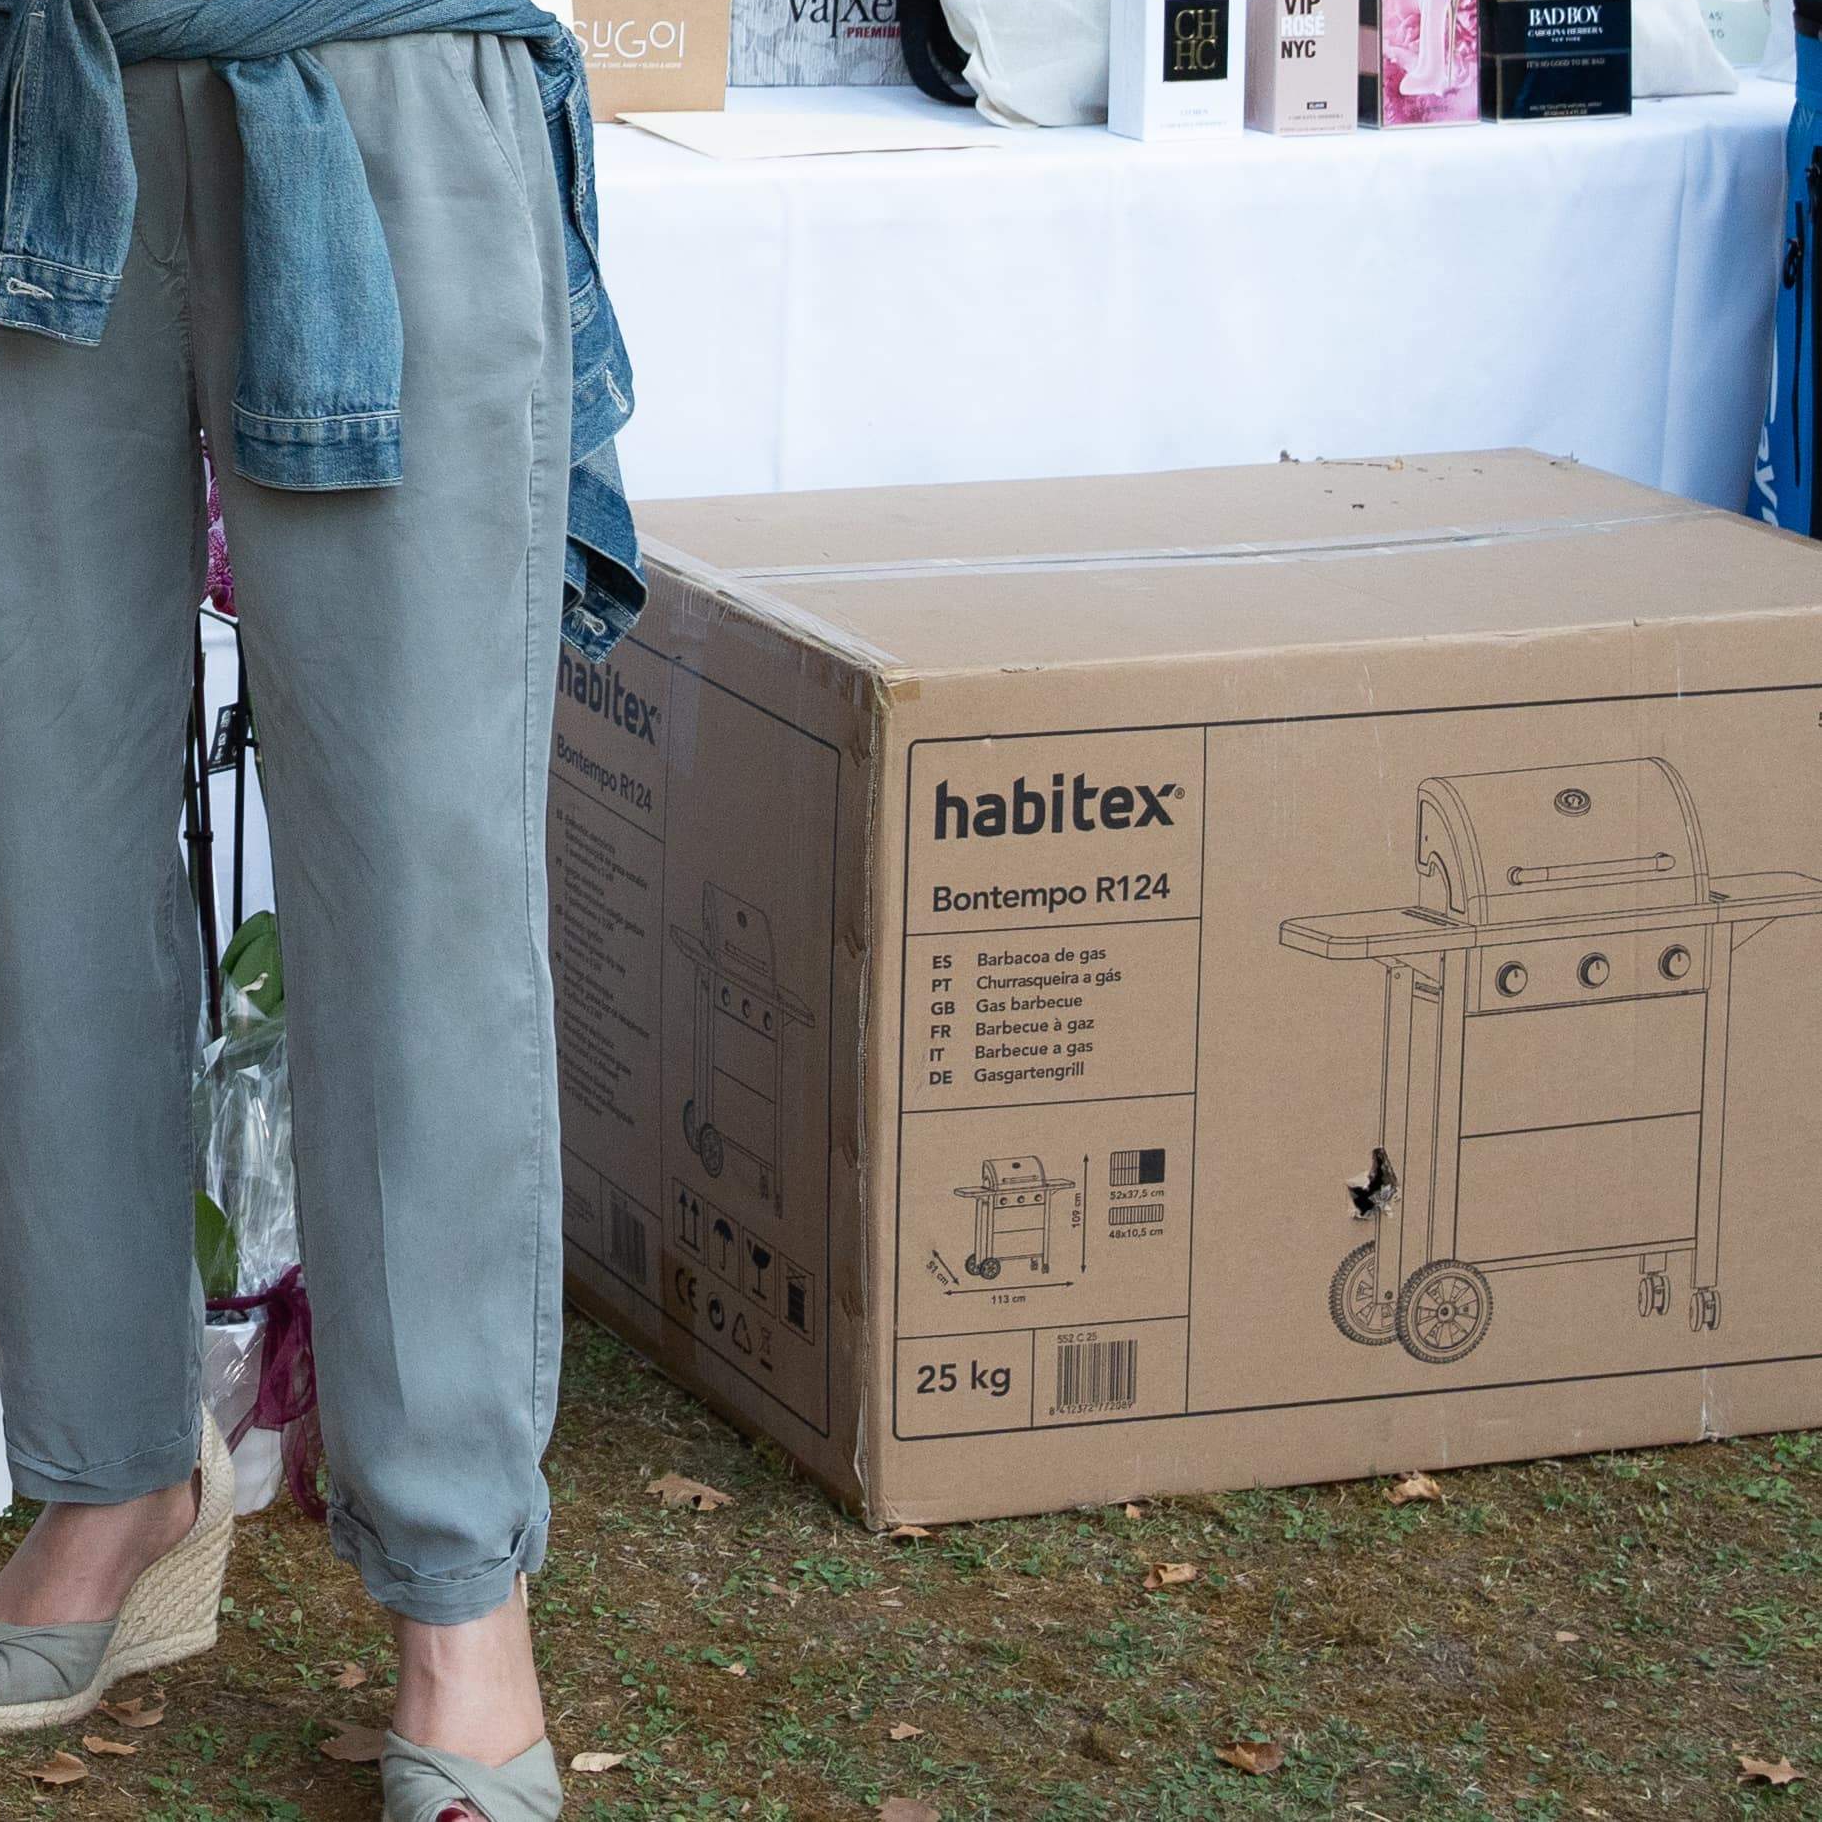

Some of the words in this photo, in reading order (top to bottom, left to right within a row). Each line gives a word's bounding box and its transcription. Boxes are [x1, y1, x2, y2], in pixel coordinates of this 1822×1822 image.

[1174, 9, 1220, 41] CH
[1529, 6, 1565, 27] BAD
[1567, 4, 1603, 25] BOY
[1173, 39, 1218, 70] HC
[1281, 39, 1317, 59] NYC
[620, 772, 653, 814] R124
[933, 884, 1087, 914] Bontempo
[1096, 872, 1171, 903] R124
[932, 955, 952, 969] ES
[977, 951, 1050, 967] Barbacoa
[1054, 947, 1075, 962] de
[1079, 948, 1107, 965] gas
[931, 978, 952, 992] PT
[976, 970, 1079, 990] Churrasqueira
[1083, 973, 1092, 983] a
[1095, 968, 1122, 986] gás
[931, 1001, 955, 1015] GB
[976, 999, 1006, 1013] Gas
[1011, 995, 1083, 1011] barbecue
[930, 1024, 951, 1039] FR
[975, 1020, 1048, 1036] Barbecue
[1053, 1017, 1062, 1032] à
[1067, 1018, 1094, 1034] gaz
[929, 1048, 944, 1062] IT
[974, 1043, 1048, 1059] Barbecue
[1052, 1044, 1061, 1054] a
[1066, 1041, 1093, 1057] gas
[929, 1070, 953, 1085] DE
[974, 1061, 1084, 1084] Gasgartengrill
[1074, 1192, 1081, 1207] cm
[1109, 1190, 1148, 1201] 52x37,5
[1150, 1190, 1165, 1198] cm
[1072, 1208, 1081, 1228] 109
[1108, 1228, 1147, 1239] 48x10,5
[926, 1261, 937, 1275] 51
[934, 1271, 949, 1286] cm
[991, 1295, 1010, 1304] 113
[1012, 1295, 1026, 1303] cm
[1076, 1333, 1085, 1342] C
[1086, 1332, 1098, 1341] 25
[917, 1362, 957, 1394] 25
[971, 1360, 1011, 1397] kg
